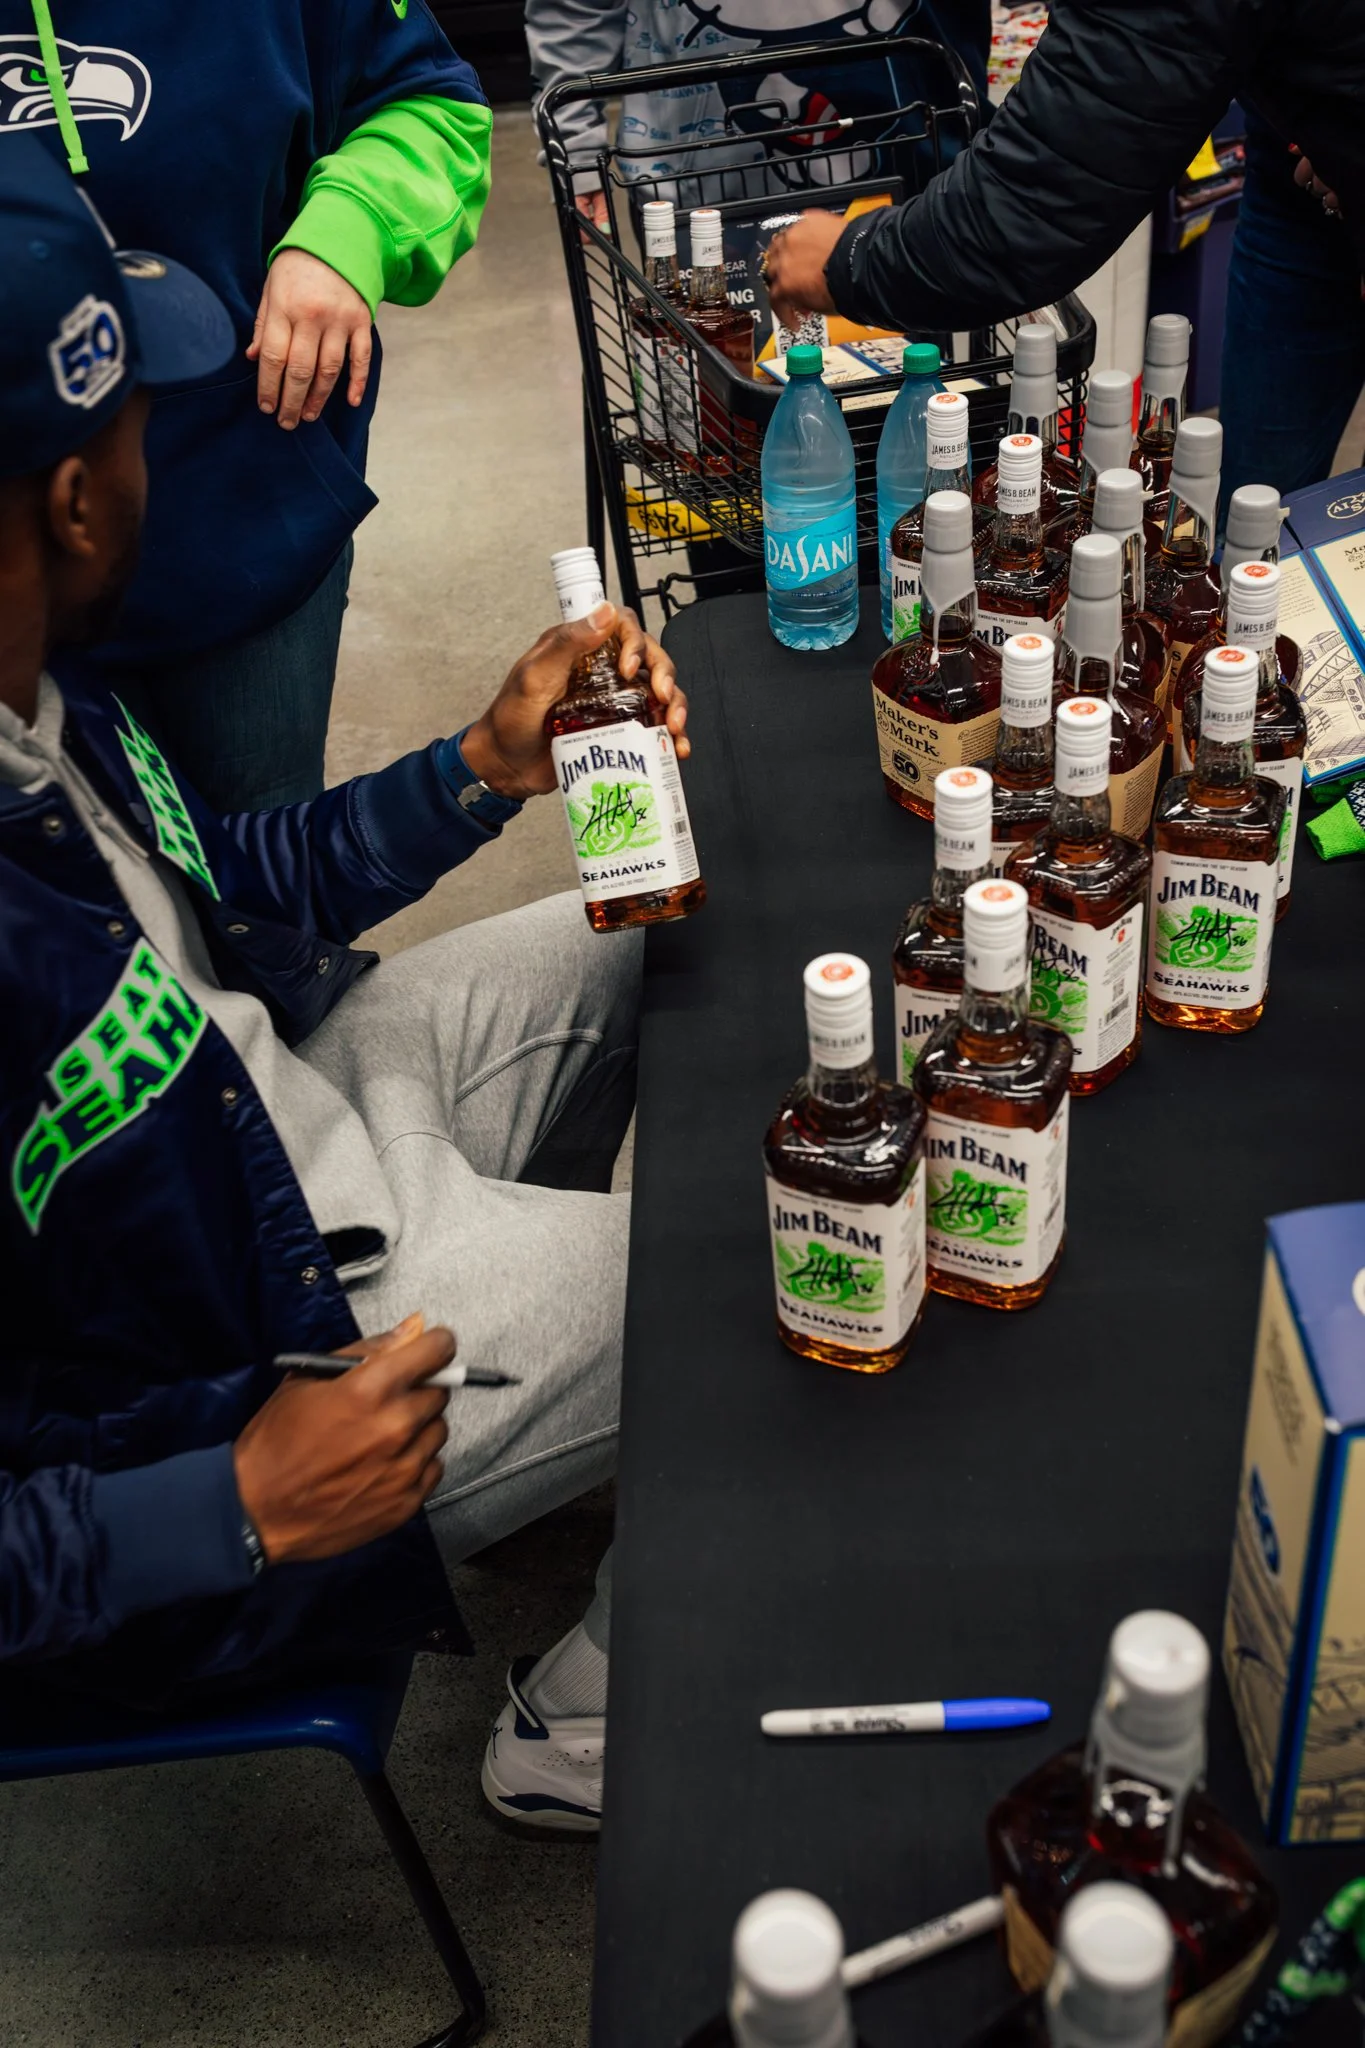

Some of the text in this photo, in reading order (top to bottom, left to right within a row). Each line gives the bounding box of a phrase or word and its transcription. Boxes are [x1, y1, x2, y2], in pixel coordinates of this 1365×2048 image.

[931, 444, 951, 456] JAMES
[1018, 487, 1037, 498] BEAM
[766, 532, 853, 582] DASANI
[893, 575, 917, 599] JIM
[1233, 622, 1259, 634] JAMES
[1028, 696, 1048, 708] BEAM
[875, 692, 940, 741] Maker's
[1204, 710, 1226, 723] JAMES
[889, 723, 941, 757] Mark
[560, 744, 649, 794] JIM BEAM
[894, 755, 918, 781] 50
[1068, 766, 1095, 779] JAMES
[581, 859, 667, 883] SEAHAWKS
[1157, 873, 1261, 914] JIM BEAM
[1034, 923, 1089, 977] BEAM
[1152, 971, 1251, 993] SEAHAWKS
[901, 1009, 941, 1038] JIM
[960, 1135, 1028, 1184] BEAM
[773, 1204, 884, 1255] JIM BEAM
[779, 1297, 884, 1334] SEAHAWKS
